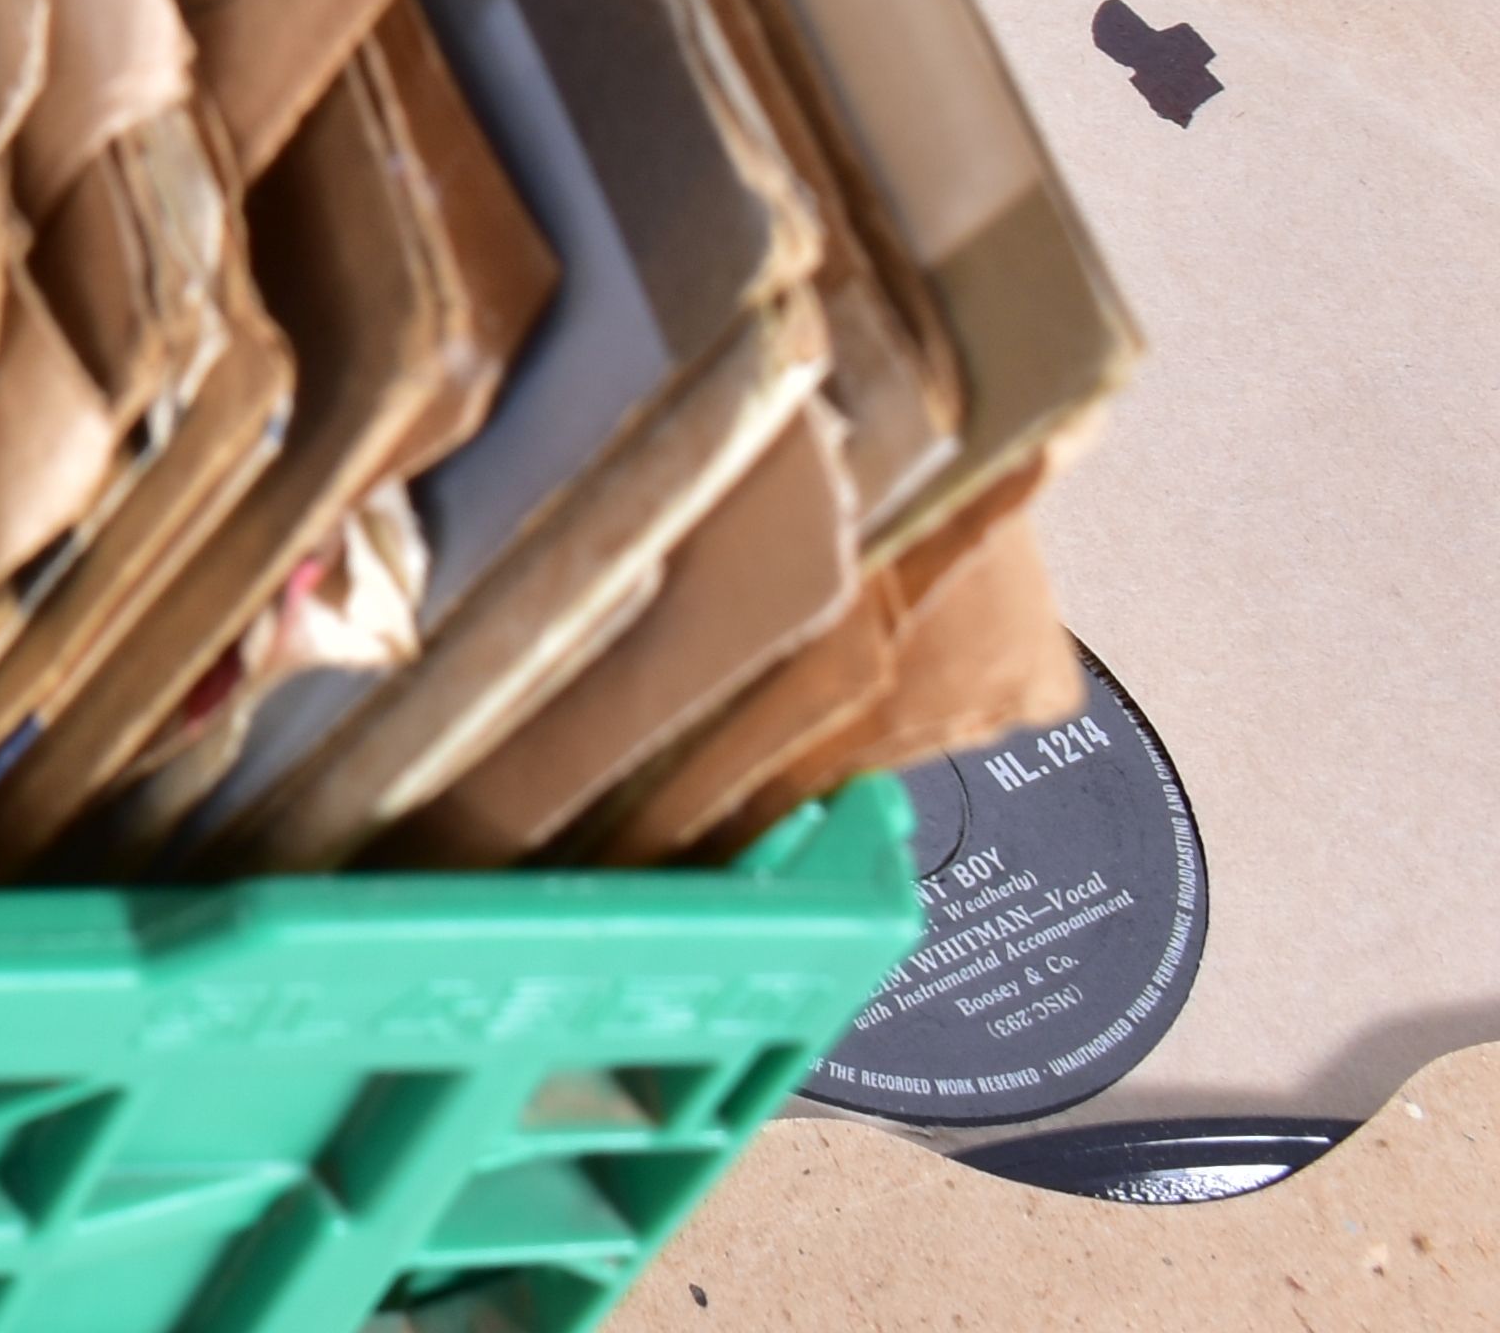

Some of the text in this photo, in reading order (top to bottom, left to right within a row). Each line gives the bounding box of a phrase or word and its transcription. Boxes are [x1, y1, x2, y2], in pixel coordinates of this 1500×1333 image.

[984, 715, 1111, 792] HL.1214
[1162, 783, 1187, 814] AND
[953, 846, 1006, 888] BOY
[1171, 817, 1197, 910] BROADCASTING
[942, 869, 1038, 922] Weatherly)
[853, 1002, 893, 1031] with
[893, 949, 1001, 1011] Instrumental
[1006, 890, 1135, 961] Accompaniment
[1152, 910, 1193, 989] PERFORMANCE
[955, 953, 1080, 1017] Boosey & Co.
[1126, 984, 1162, 1024] PUBLIC
[1048, 1018, 1133, 1076] UNAUTHORISED
[828, 1061, 856, 1083] THE
[861, 1069, 932, 1095] RECORDED
[935, 1078, 977, 1096] WORK
[977, 1067, 1041, 1094] RESERVED
